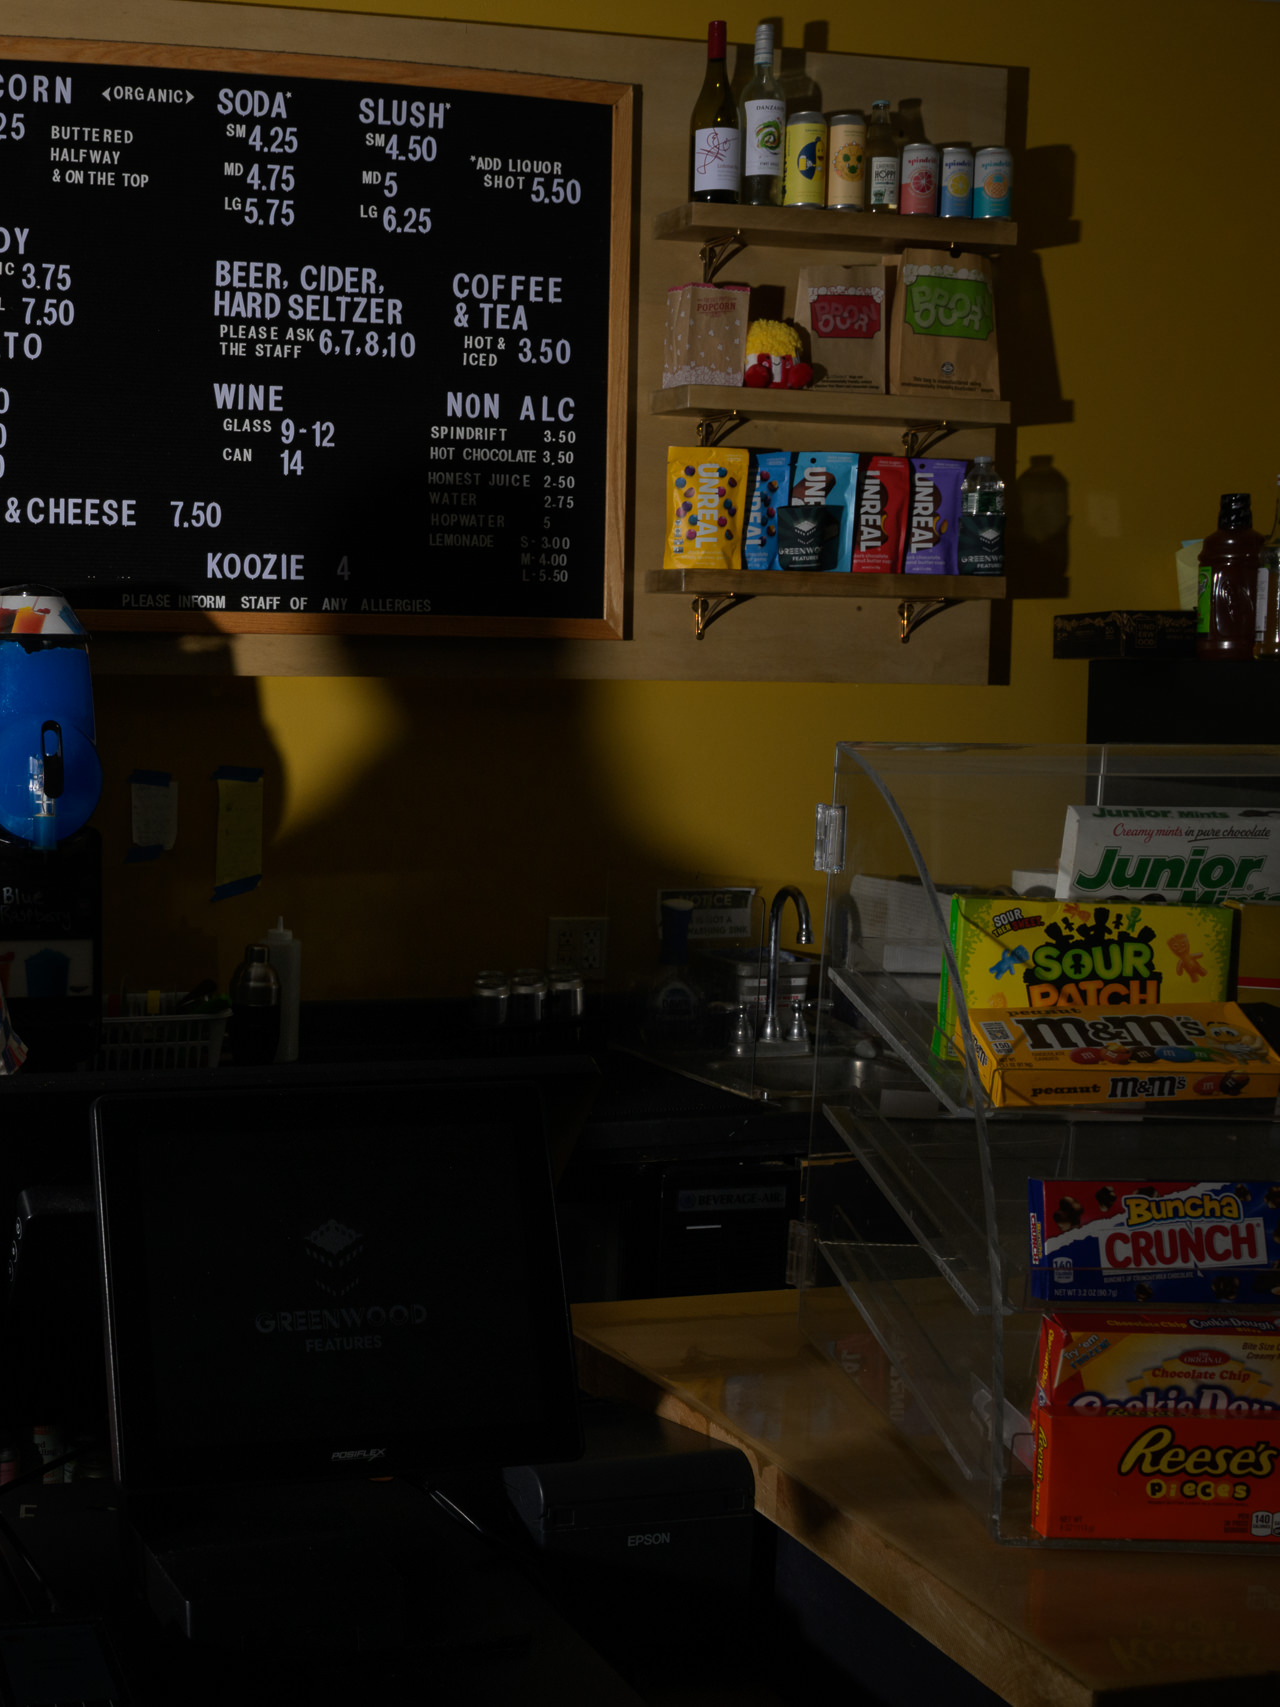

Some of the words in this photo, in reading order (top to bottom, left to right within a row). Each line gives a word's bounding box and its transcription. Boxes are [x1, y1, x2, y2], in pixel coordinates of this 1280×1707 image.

[51, 126, 133, 143] BUTTERED
[50, 148, 120, 165] HALFWAY
[509, 159, 562, 175] LIQUOR
[52, 169, 61, 182] &
[65, 170, 83, 184] ON
[88, 171, 115, 186] THE
[123, 173, 149, 187] TOP
[484, 174, 524, 190] SHOT
[530, 178, 581, 204] 5.50
[22, 263, 71, 291] 3.75
[215, 260, 289, 290] BEER,
[300, 265, 385, 294] CIDER,
[453, 273, 562, 303] COFFEE
[22, 297, 74, 325] 7.50
[214, 291, 280, 319] HARD
[288, 295, 402, 325] SELTZER
[697, 302, 736, 312] POPCORN
[454, 302, 469, 328] &
[480, 303, 528, 331] TEA
[220, 325, 279, 340] PLEASE
[286, 327, 315, 342] ASK
[220, 342, 246, 356] THE
[255, 344, 301, 359] STAFF
[213, 383, 283, 412] WINE
[446, 391, 500, 420] NON
[520, 395, 575, 423] ALC
[223, 419, 272, 433] GLASS
[431, 426, 507, 442] SPINDRIFT
[544, 430, 576, 444] 3.50
[223, 448, 252, 462] CAN
[430, 447, 455, 461] HOT
[463, 448, 536, 464] CHOCOLATE
[542, 450, 574, 465] 3.50
[428, 472, 480, 486] HONEST
[488, 473, 530, 488] JUICE
[428, 491, 477, 506] WATER
[695, 463, 719, 549] UNREAL
[859, 470, 880, 552] UNREAL
[908, 472, 934, 553] UNREAL
[431, 513, 504, 528] HOPWATER
[429, 534, 494, 548] LEMONADE
[207, 552, 305, 581] KOOZIE
[336, 555, 351, 581] 4
[122, 594, 170, 608] PLEASE
[178, 594, 225, 609] INFORM
[241, 596, 280, 610] STAFF
[290, 597, 307, 611] OF
[322, 597, 348, 612] ANY
[361, 598, 431, 613] ALLERGIES
[1092, 807, 1172, 819] Junior
[1178, 811, 1229, 819] Mints
[1113, 823, 1153, 842] Creamy
[1156, 826, 1182, 837] mints
[1185, 827, 1195, 837] in
[1195, 828, 1221, 841] pure
[1223, 826, 1271, 838] chocolate
[1076, 847, 1265, 890] Junior
[993, 908, 1023, 928] SOUR
[993, 925, 1011, 937] THEN
[1033, 942, 1153, 980] SOUR
[1028, 980, 1158, 1007] PATCH
[1008, 1008, 1081, 1017] peanut
[1032, 1084, 1100, 1097] peanut
[1126, 1194, 1239, 1225] Buncha
[1105, 1223, 1257, 1268] CRUNCH
[255, 1304, 428, 1334] GREENWOOD
[305, 1335, 383, 1353] FEATURES
[1184, 1356, 1222, 1364] ORIGINAL
[1152, 1369, 1215, 1379] Chocolate
[1220, 1371, 1250, 1382] Chip
[331, 1447, 386, 1461] POSIFLEX
[1120, 1426, 1277, 1476] Reese's
[1254, 1514, 1269, 1524] 140
[627, 1532, 671, 1547] EPSON
